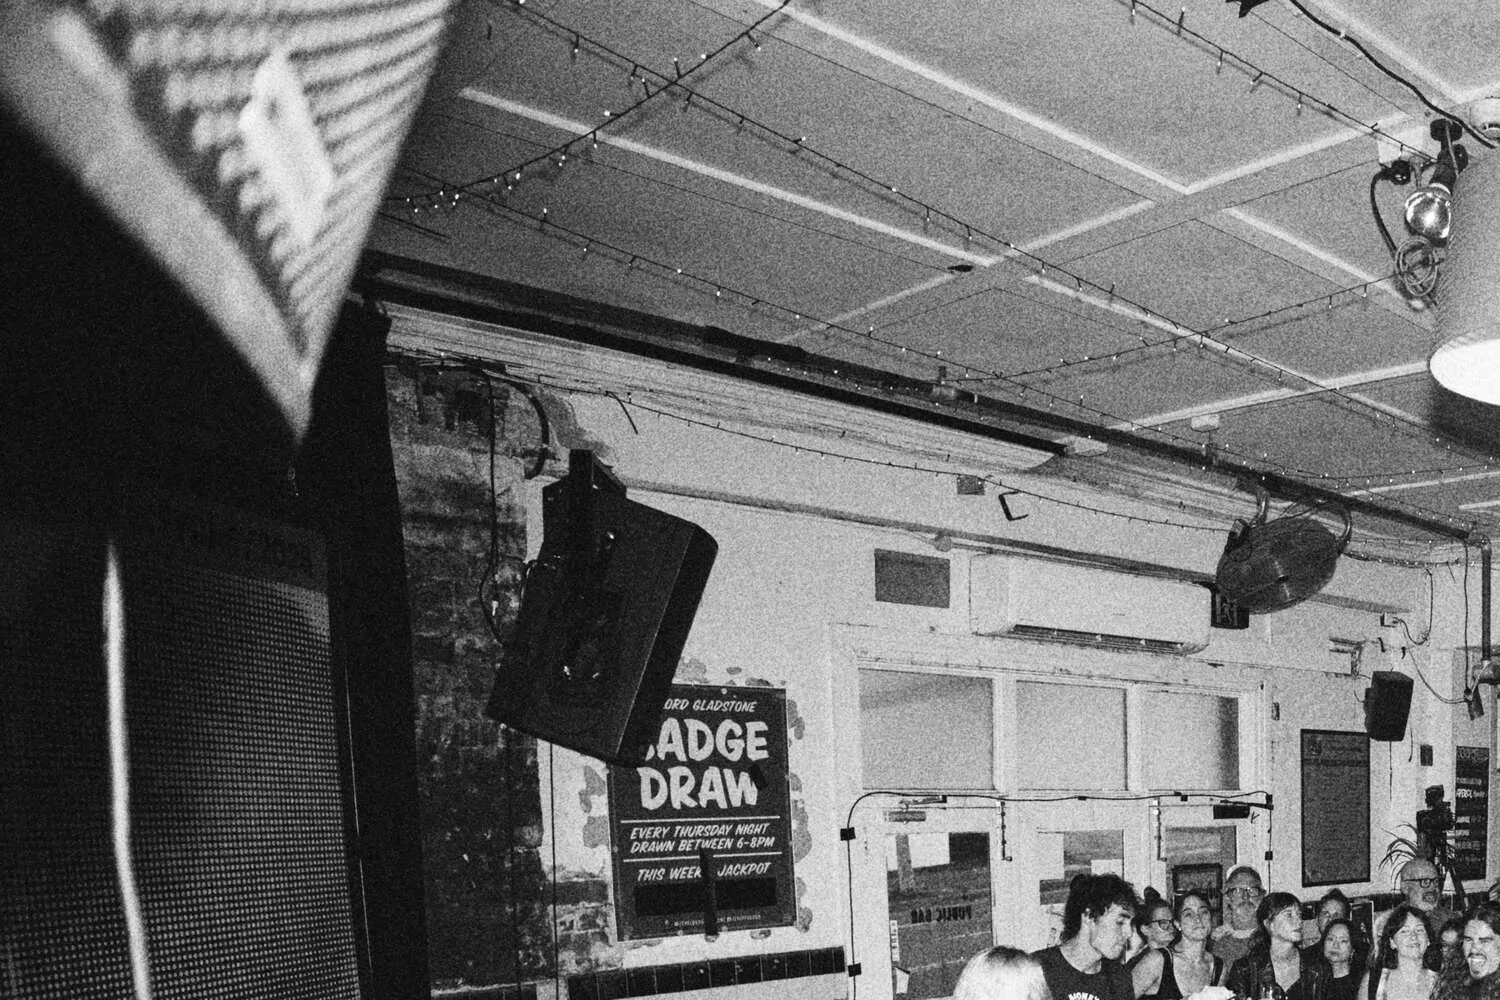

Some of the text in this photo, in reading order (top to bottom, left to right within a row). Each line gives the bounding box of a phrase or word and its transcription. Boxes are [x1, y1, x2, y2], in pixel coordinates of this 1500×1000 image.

[663, 698, 758, 713] ORD GLADSTONE
[645, 717, 769, 762] ADGE
[636, 765, 758, 810] DRAW
[630, 822, 771, 840] EVERY THURSDAY NIGHT
[630, 836, 776, 854] DRAWN BETWEEN 6-8PM
[637, 865, 702, 882] THIS WEEK
[716, 861, 772, 877] JACKPOT
